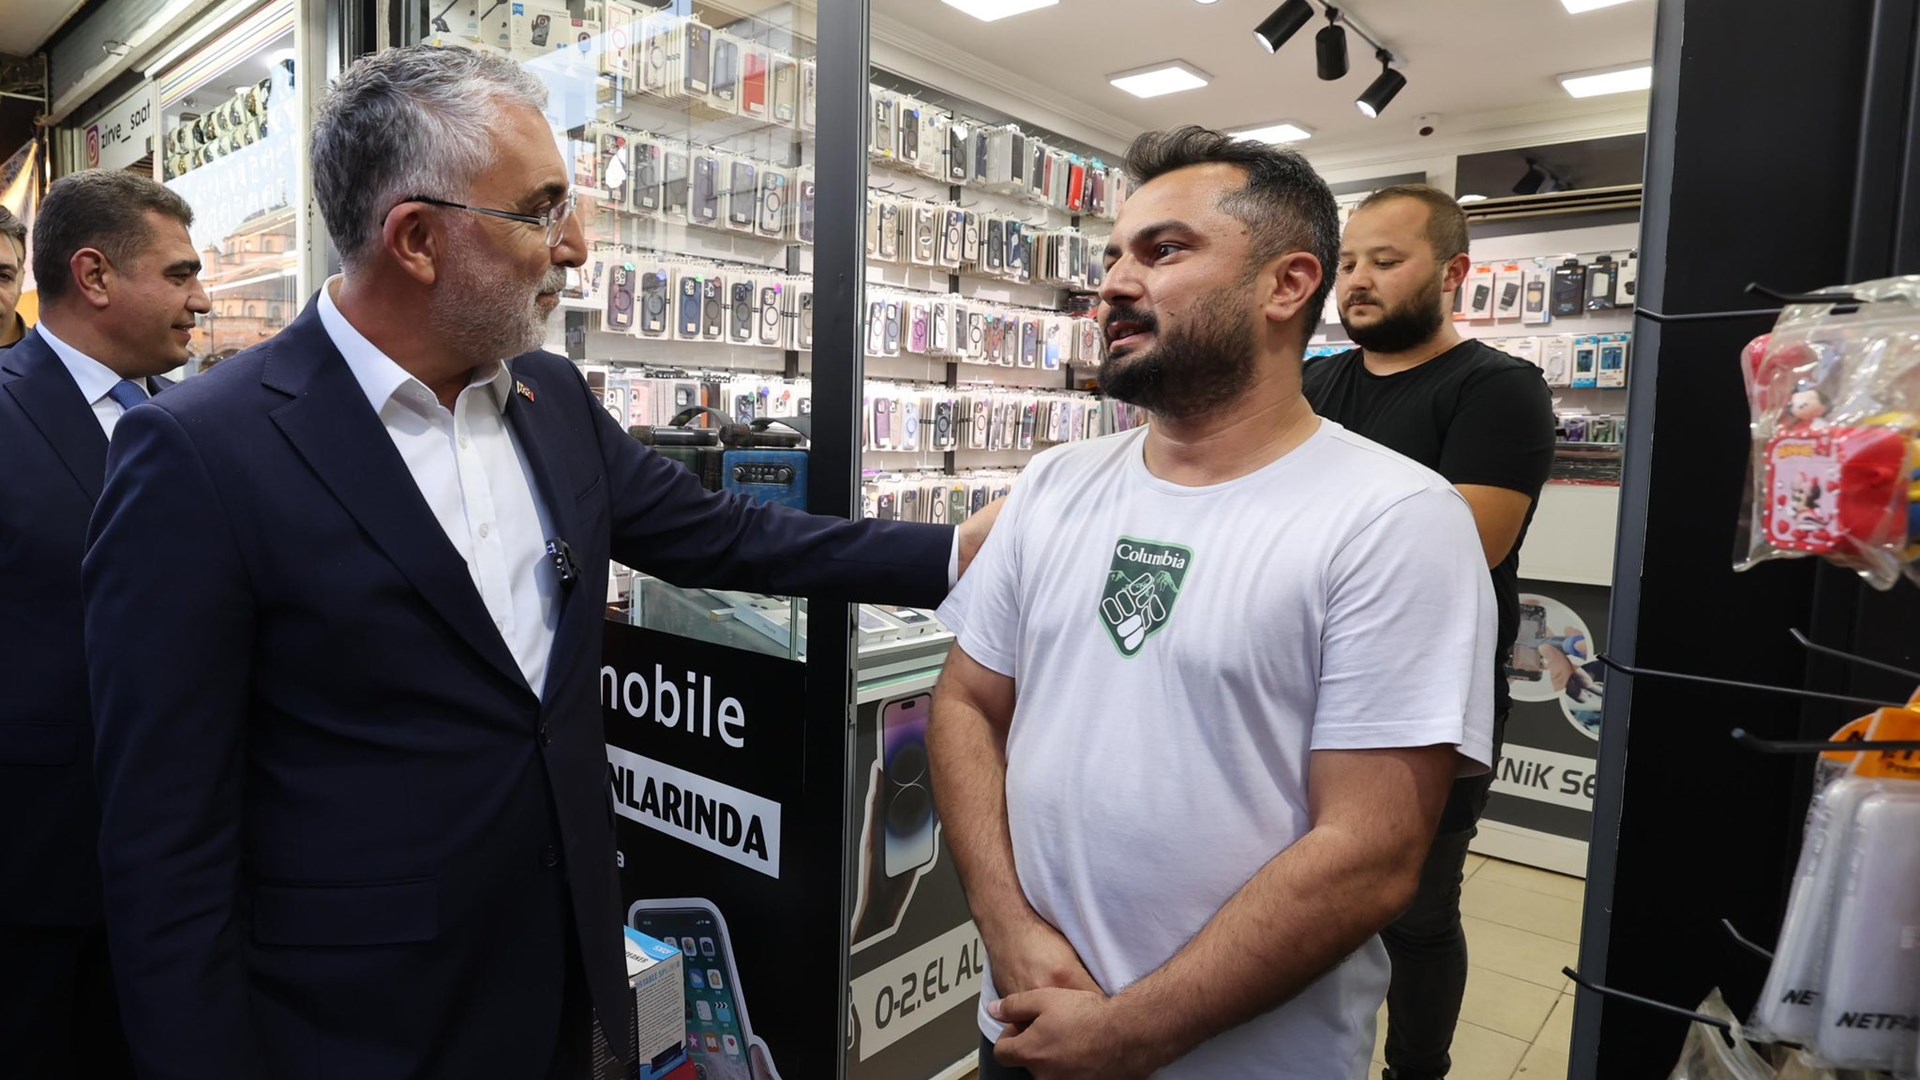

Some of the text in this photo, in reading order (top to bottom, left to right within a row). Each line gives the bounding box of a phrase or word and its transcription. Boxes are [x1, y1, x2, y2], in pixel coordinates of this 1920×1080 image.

[101, 98, 150, 149] zirve_saat
[1116, 543, 1186, 569] Columbia
[1781, 988, 1820, 1006] NE
